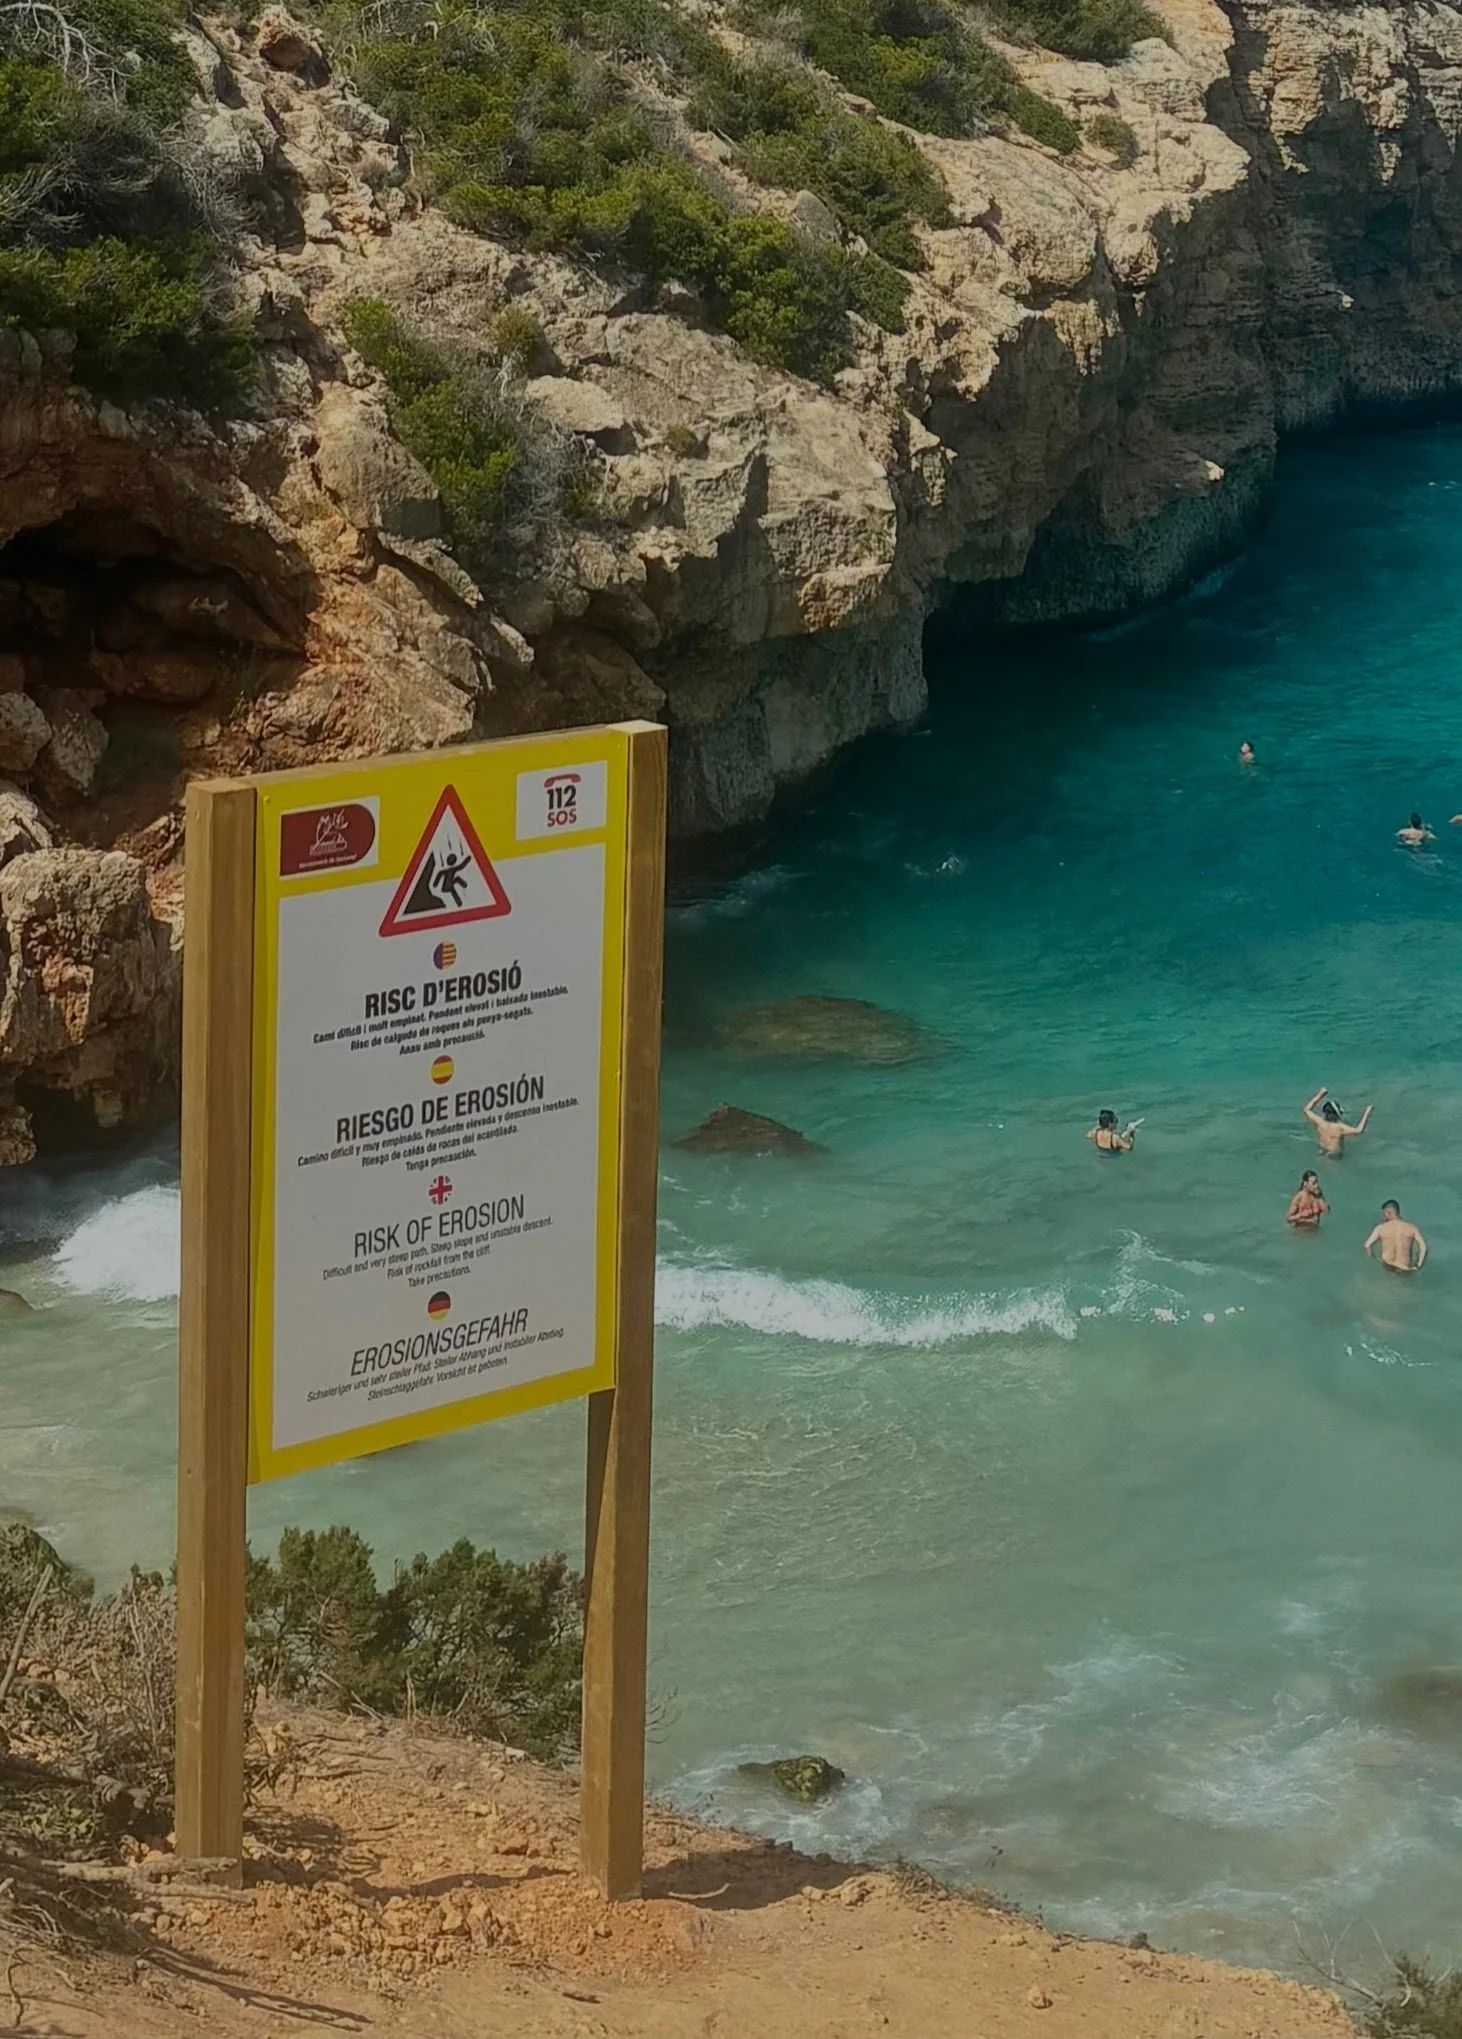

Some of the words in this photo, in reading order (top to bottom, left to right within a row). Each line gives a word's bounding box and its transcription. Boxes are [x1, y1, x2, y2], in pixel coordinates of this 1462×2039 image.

[547, 784, 577, 810] 112
[547, 808, 577, 827] SOS
[365, 985, 416, 1019] RISC
[423, 959, 522, 1007] D'EROSIÓ
[368, 1020, 388, 1033] molt
[428, 1005, 462, 1021] Pendent
[464, 1000, 489, 1014] elevat
[351, 1039, 369, 1051] Risc
[370, 1036, 382, 1047] de
[419, 1026, 430, 1037] de
[431, 1022, 460, 1035] roques
[423, 1038, 441, 1051] amb
[337, 1103, 414, 1144] RIESGO
[421, 1096, 449, 1125] DE
[455, 1073, 544, 1117] EROSIÓN
[298, 1152, 329, 1167] Camino
[355, 1146, 361, 1157] y
[362, 1141, 380, 1153] muy
[425, 1121, 464, 1138] Pendiente
[466, 1115, 496, 1129] elevada
[497, 1114, 503, 1124] y
[504, 1105, 541, 1122] descenso
[361, 1153, 389, 1168] Riesgo
[391, 1149, 401, 1161] de
[426, 1142, 437, 1153] de
[439, 1138, 461, 1150] rocas
[462, 1132, 475, 1146] del
[405, 1159, 429, 1171] Tenga
[354, 1223, 400, 1258] RISK
[407, 1216, 433, 1245] OF
[439, 1194, 524, 1237] EROSION
[323, 1265, 352, 1281] Difficult
[354, 1260, 369, 1273] and
[370, 1258, 386, 1268] very
[388, 1252, 409, 1266] steep
[431, 1241, 452, 1254] Steep
[454, 1236, 473, 1248] slope
[475, 1231, 489, 1244] and
[490, 1225, 521, 1240] unstable
[387, 1268, 404, 1279] Risk
[405, 1264, 414, 1276] of
[443, 1252, 461, 1264] from
[462, 1248, 474, 1261] the
[408, 1277, 425, 1288] Take
[351, 1308, 528, 1376] EROSIONSGEFAHR
[307, 1382, 352, 1402] Schwieriger
[354, 1377, 369, 1390] und
[370, 1373, 388, 1386] sehr
[488, 1343, 502, 1356] und
[467, 1363, 477, 1375] ist
